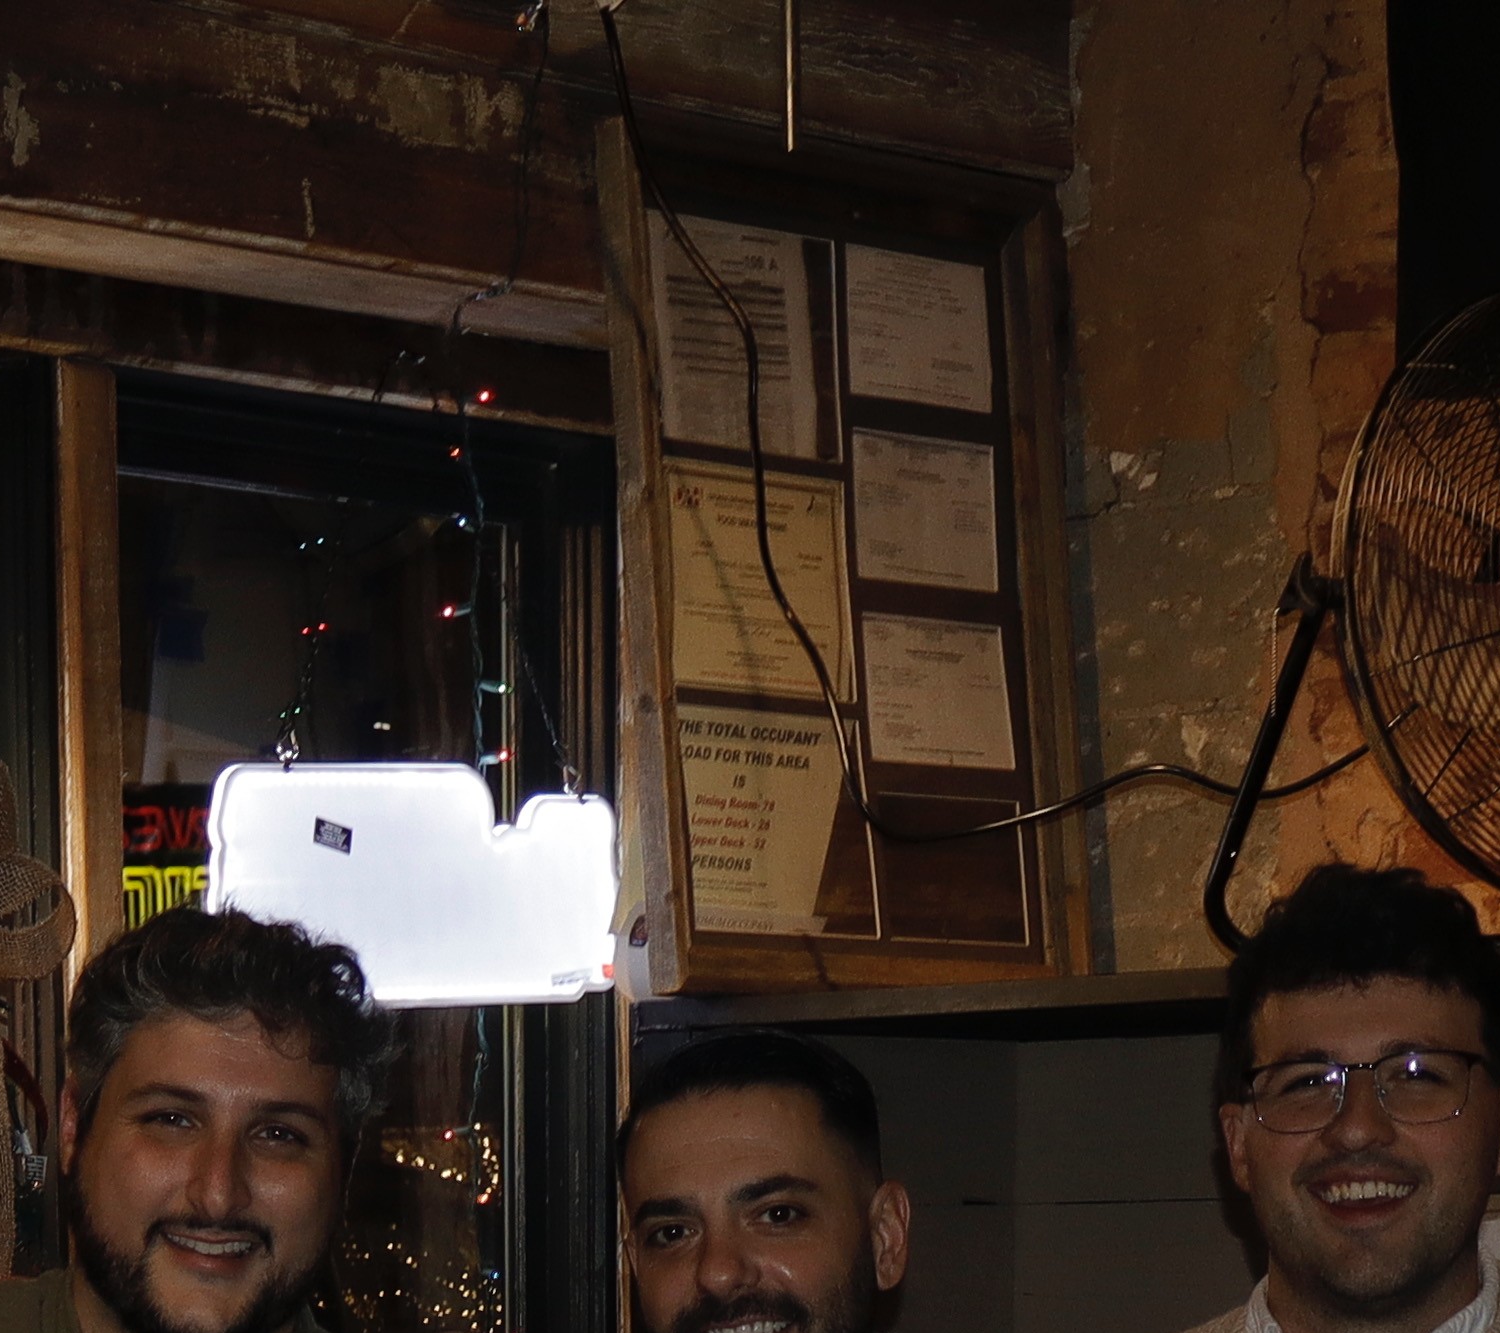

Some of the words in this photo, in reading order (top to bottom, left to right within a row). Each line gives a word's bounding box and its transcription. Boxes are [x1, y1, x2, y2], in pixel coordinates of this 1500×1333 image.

[678, 718, 704, 735] THE
[707, 721, 748, 740] TOTAL
[750, 726, 822, 747] OCCUPANT
[683, 744, 712, 761] OAD
[714, 747, 742, 764] FOR
[745, 750, 774, 768] THIS
[776, 754, 811, 771] AREA
[692, 853, 753, 873] PERSONS
